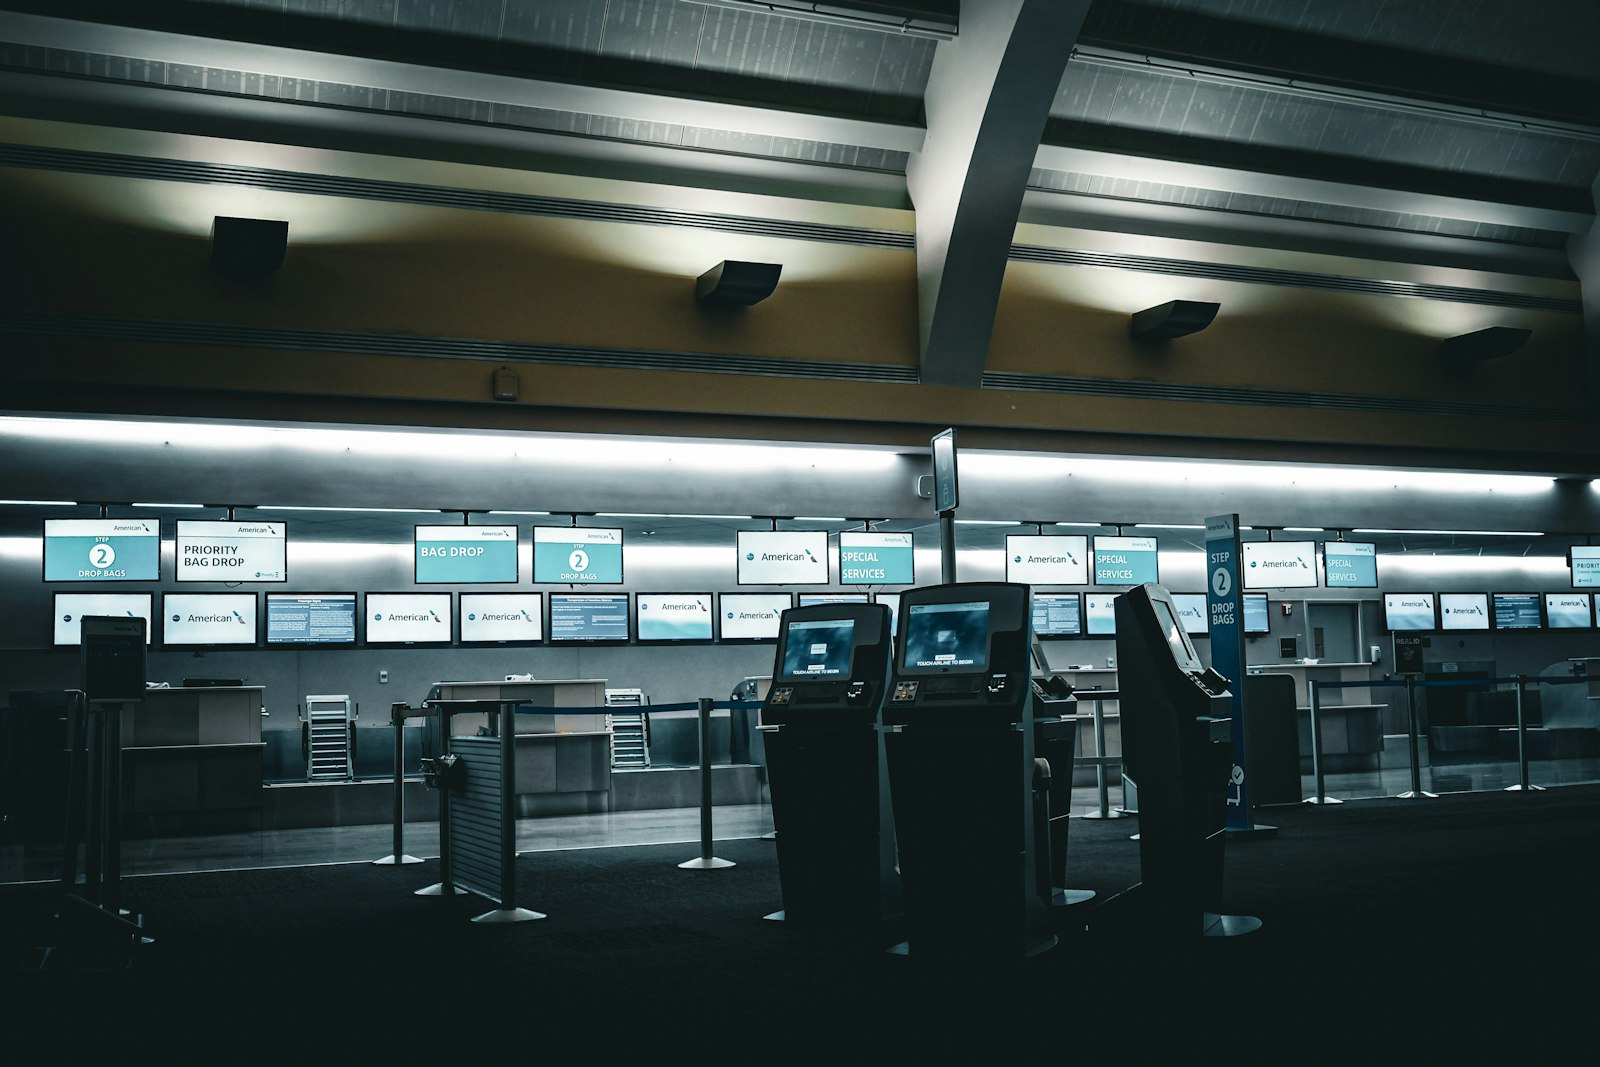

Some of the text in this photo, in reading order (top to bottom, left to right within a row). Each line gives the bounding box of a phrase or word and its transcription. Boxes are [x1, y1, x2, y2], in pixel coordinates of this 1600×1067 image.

[184, 546, 238, 555] PRIORITY
[421, 547, 484, 557] BAG DROP
[97, 549, 107, 564] 2
[575, 554, 583, 568] 2
[762, 552, 804, 562] American
[842, 552, 878, 562] SPECIAL
[1028, 554, 1067, 564] American
[1097, 555, 1127, 564] SPECIAL
[1211, 552, 1230, 563] STEP
[184, 558, 244, 567] BAG DROP
[1262, 560, 1297, 568] American
[1328, 559, 1352, 568] SPECIAL
[842, 569, 885, 579] SERVICES
[1097, 570, 1133, 579] SERVICES
[1328, 573, 1357, 582] SERVICES
[1218, 572, 1226, 590] 2
[662, 602, 696, 611] American
[1212, 602, 1234, 614] DROP
[188, 614, 232, 622] American
[388, 613, 429, 622] American
[482, 612, 521, 622] American
[739, 611, 774, 620] American
[1213, 614, 1234, 625] BAGS
